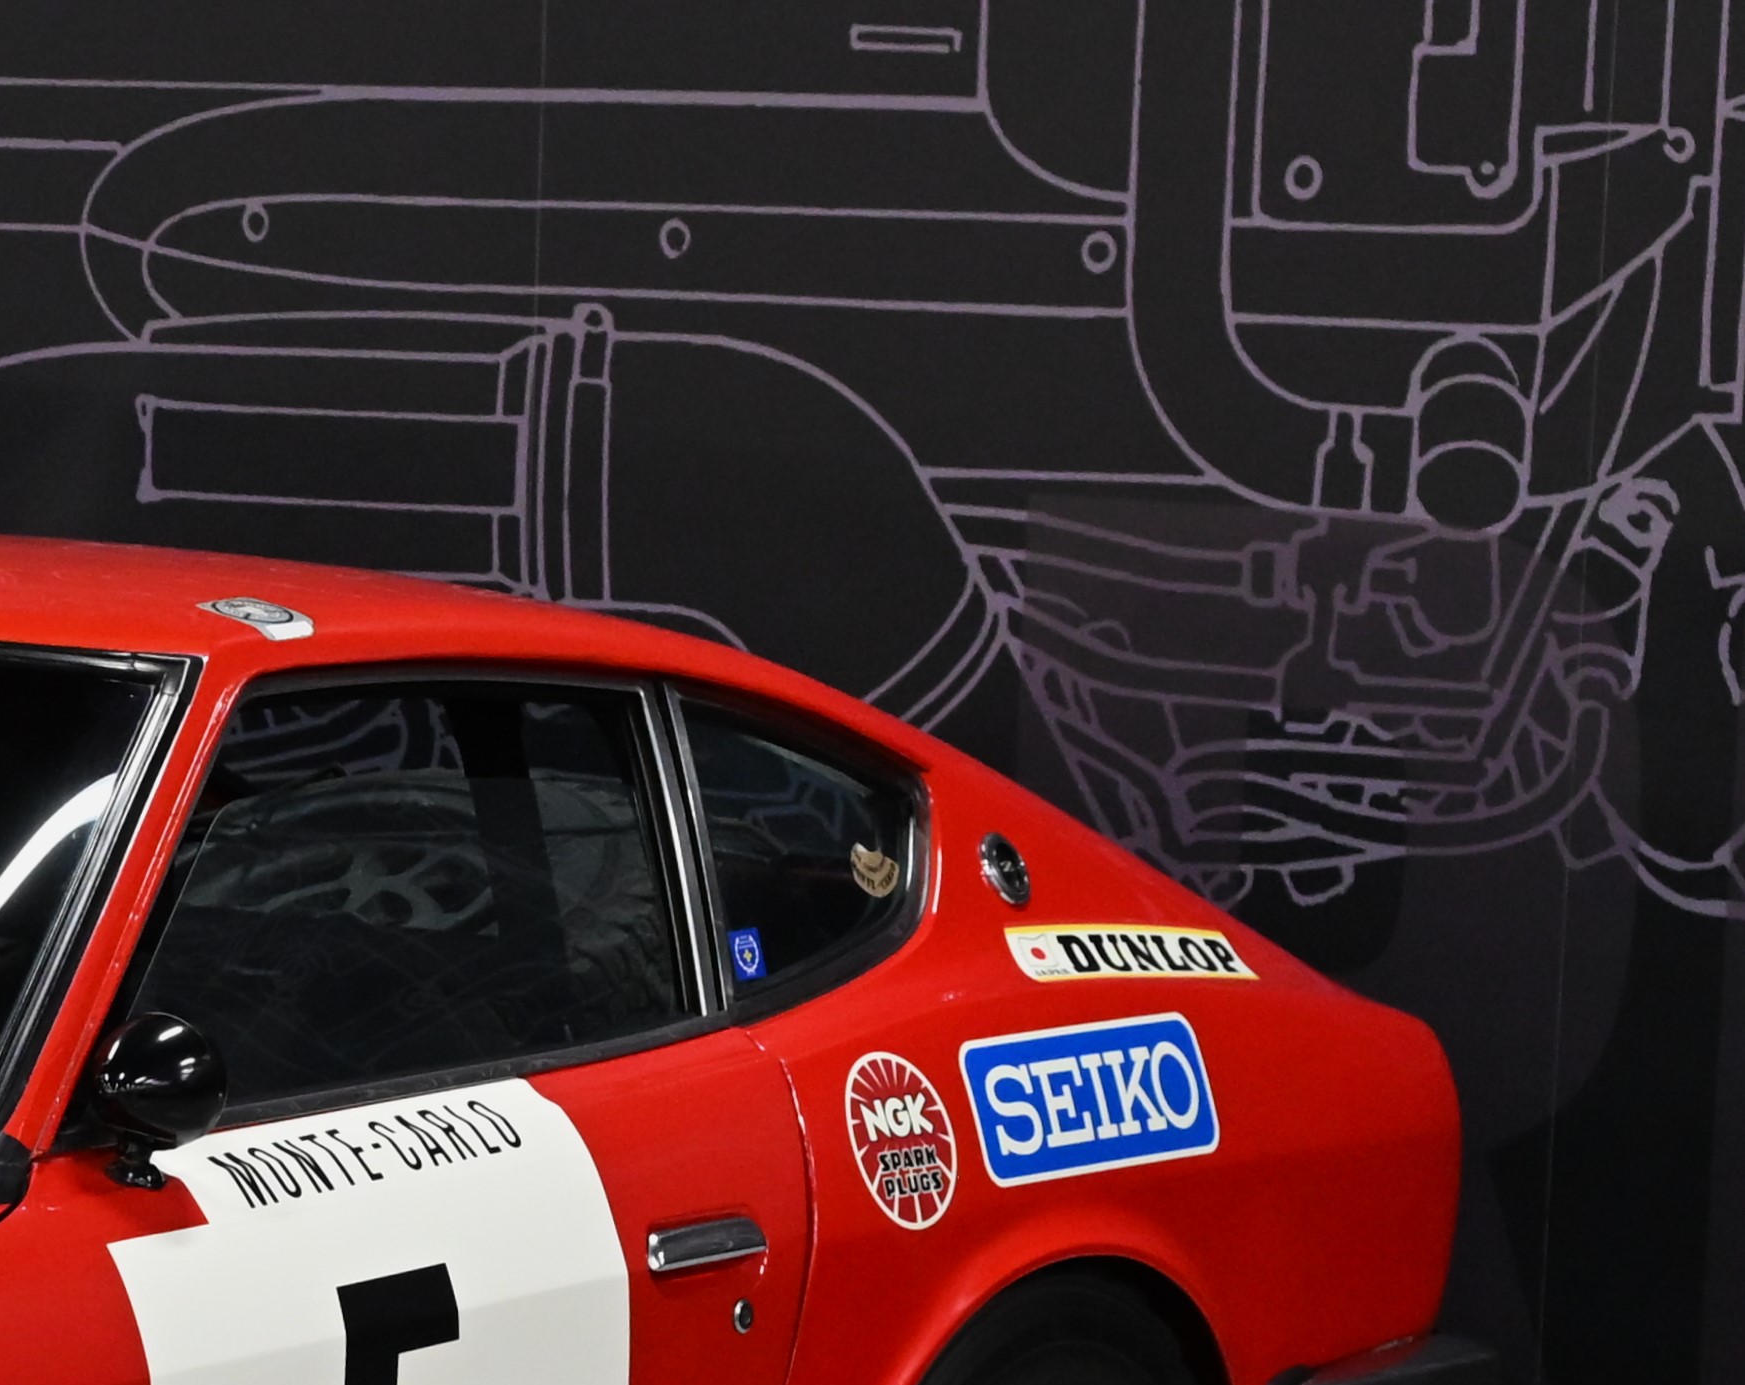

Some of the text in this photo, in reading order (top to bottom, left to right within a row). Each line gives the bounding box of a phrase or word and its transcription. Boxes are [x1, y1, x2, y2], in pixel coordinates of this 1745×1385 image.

[1056, 934, 1240, 974] DUNLOP
[859, 1092, 934, 1142] NGK
[984, 1040, 1200, 1156] SEIKO
[207, 1099, 522, 1209] MONTE-CARLO
[878, 1146, 938, 1172] SPARK
[883, 1171, 943, 1198] PLUGS
